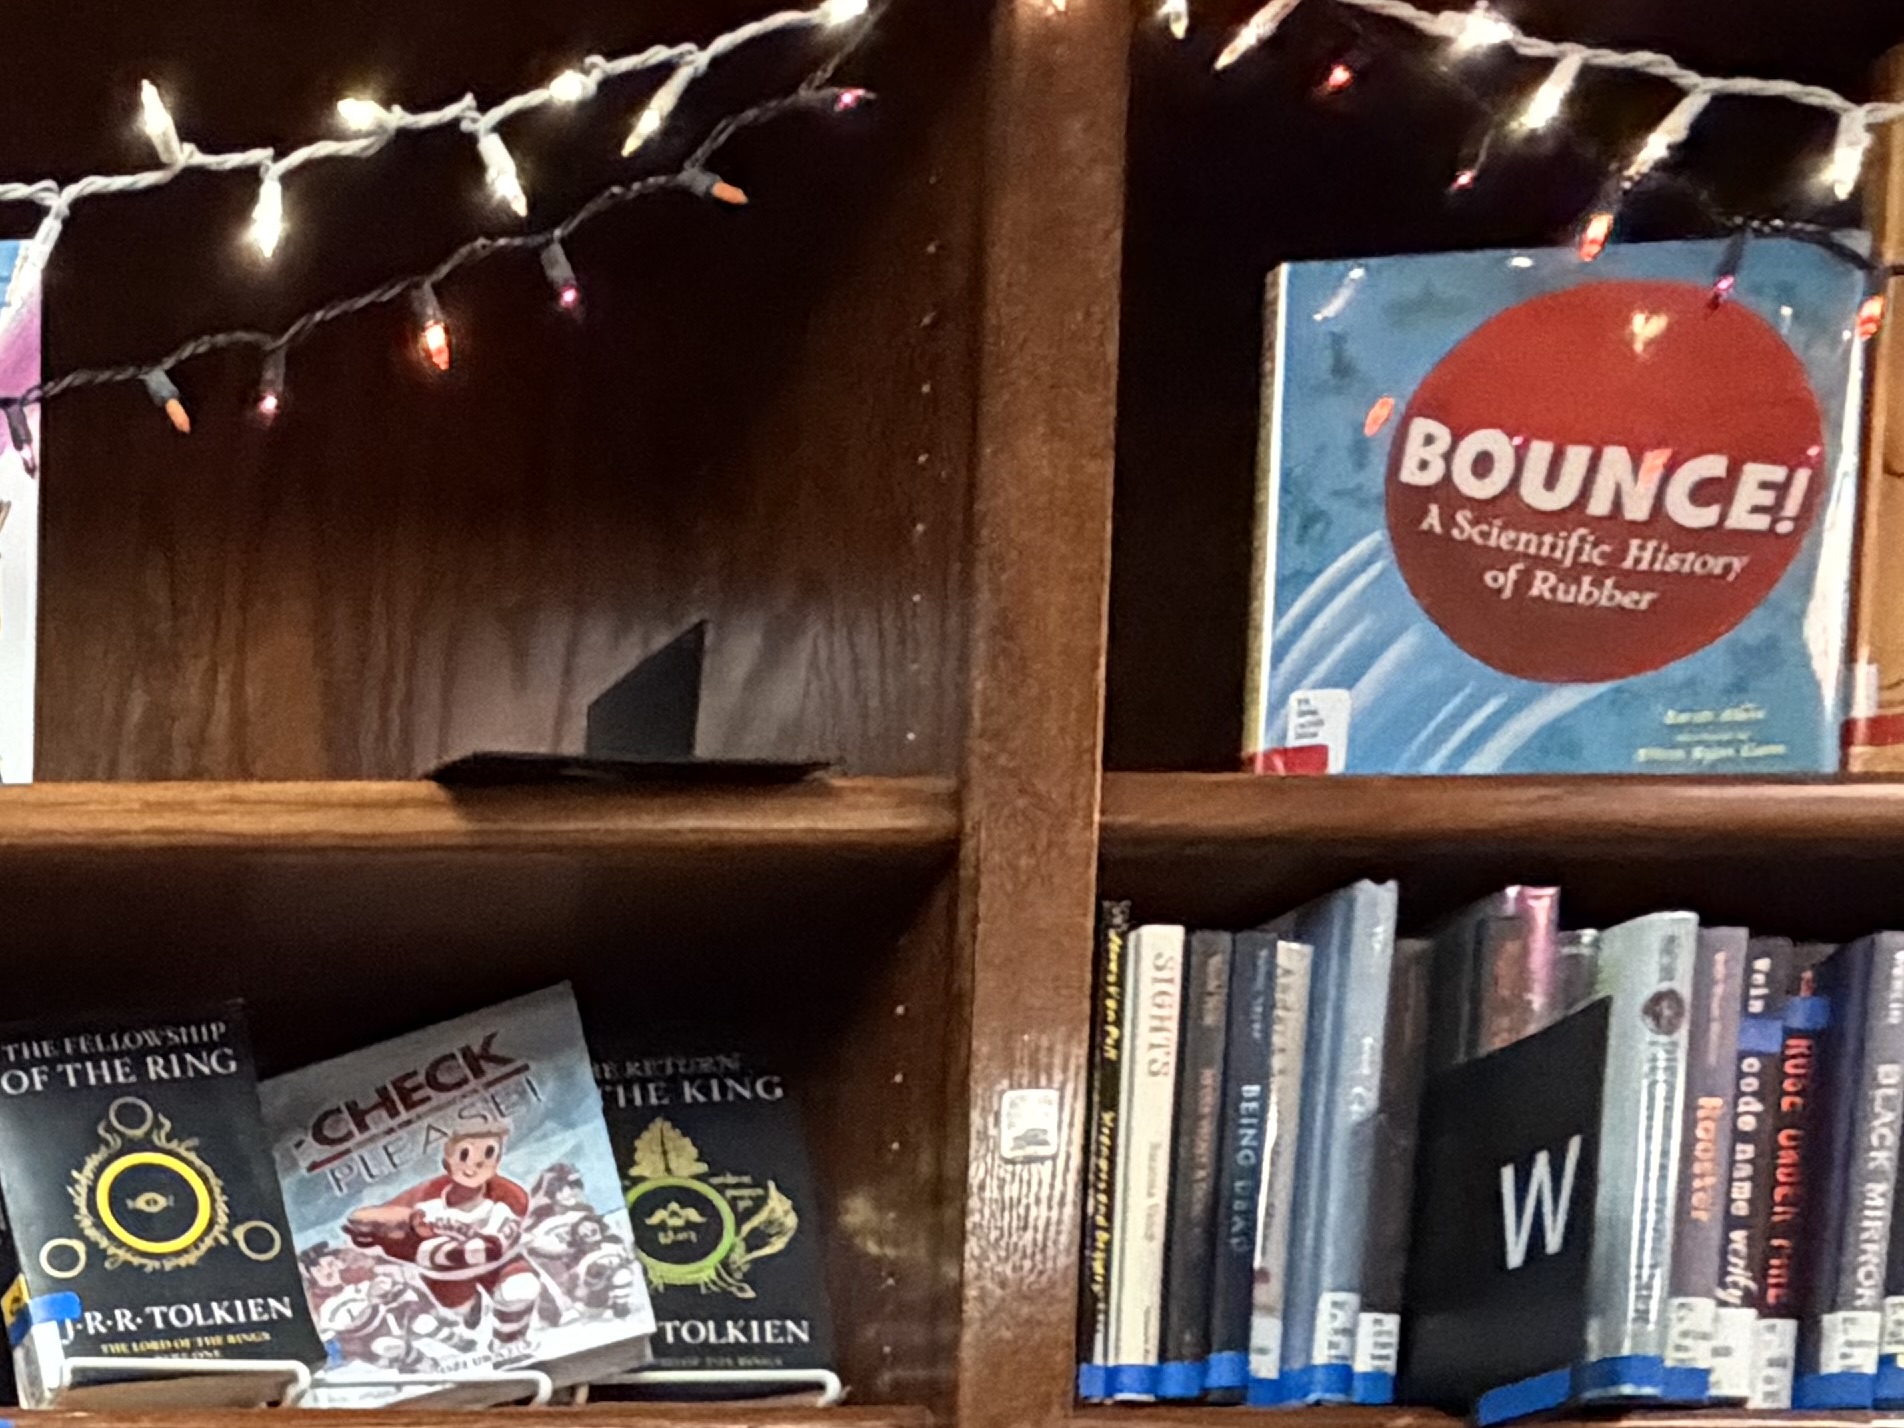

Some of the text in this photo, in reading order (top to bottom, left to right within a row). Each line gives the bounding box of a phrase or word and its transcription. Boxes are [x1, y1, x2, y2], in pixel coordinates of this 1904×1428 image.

[1398, 417, 1812, 533] BOUNCE!
[1419, 505, 1747, 581] A Scientific History
[1484, 564, 1657, 612] of Rubber
[0, 1047, 239, 1096] OF THE RING
[1, 1021, 227, 1063] THE FELLOWSHIP
[683, 1075, 783, 1106] KING
[326, 1076, 542, 1199] PLEASE!
[1500, 1134, 1583, 1269] W
[1715, 1056, 1764, 1305] code name verify
[1853, 1063, 1903, 1308] BLACK MIRROR
[664, 1320, 811, 1346] TOLKIEN
